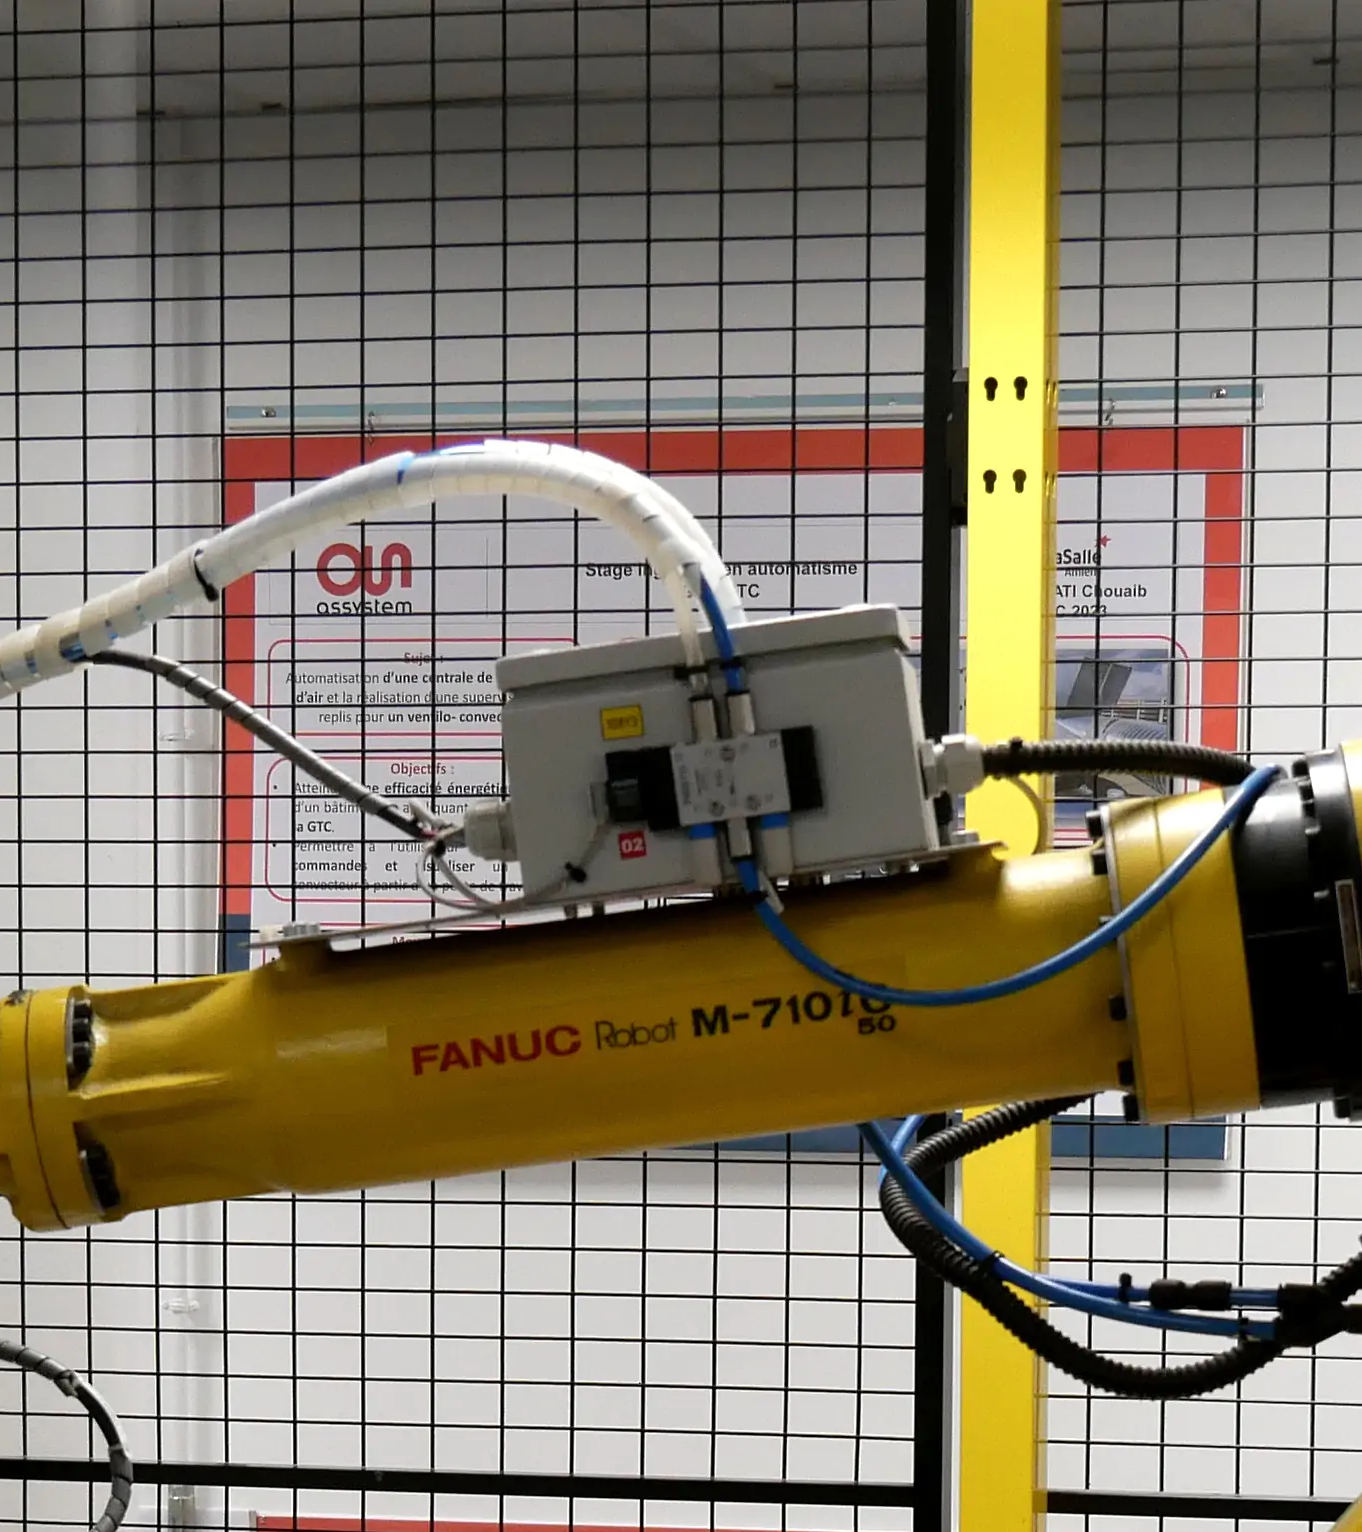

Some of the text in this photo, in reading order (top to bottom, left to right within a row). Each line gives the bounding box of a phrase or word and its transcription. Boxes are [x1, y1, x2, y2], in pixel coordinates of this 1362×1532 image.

[585, 562, 633, 580] Stage
[748, 563, 858, 576] automatisme
[383, 671, 419, 684] d'une
[477, 672, 493, 684] de
[296, 691, 324, 703] d'air
[326, 692, 339, 703] et
[342, 691, 353, 703] la
[319, 713, 352, 727] replis
[388, 716, 404, 724] un
[307, 822, 335, 833] GTC.
[621, 837, 646, 854] 02
[385, 861, 398, 872] et
[857, 1014, 896, 1036] 50
[411, 1025, 582, 1077] FANUC
[594, 1016, 678, 1051] Robot
